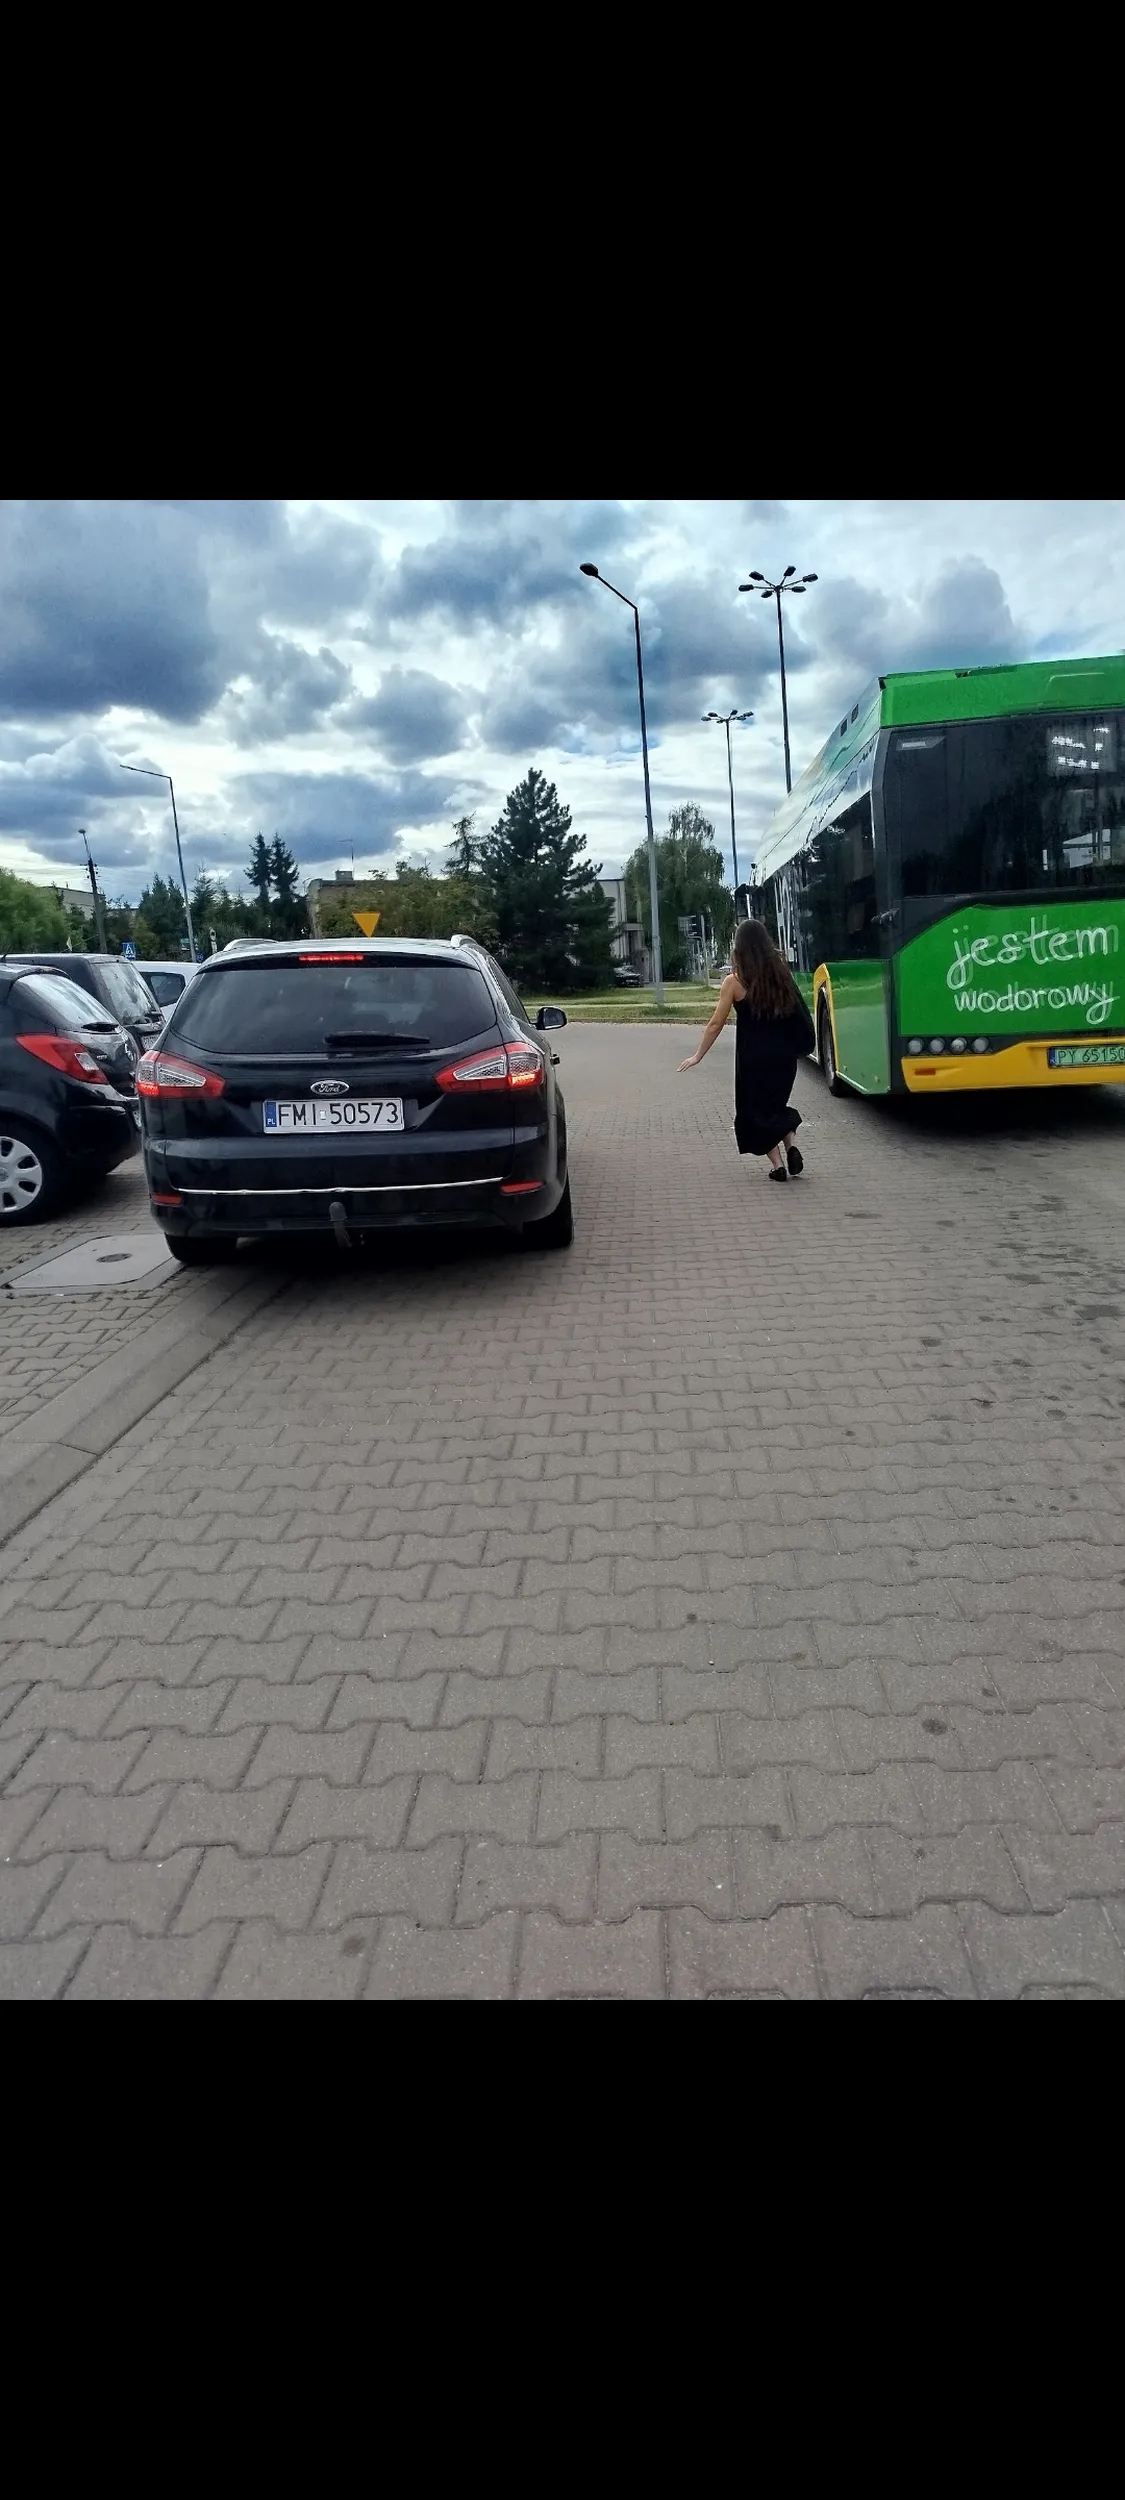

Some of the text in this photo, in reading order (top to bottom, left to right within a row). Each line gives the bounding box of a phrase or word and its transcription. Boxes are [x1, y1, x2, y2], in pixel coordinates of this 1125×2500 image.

[947, 915, 1118, 990] jestem
[953, 981, 1120, 1024] wodorowy
[1057, 1047, 1125, 1064] PY 65150
[278, 1102, 399, 1126] FMI 50573
